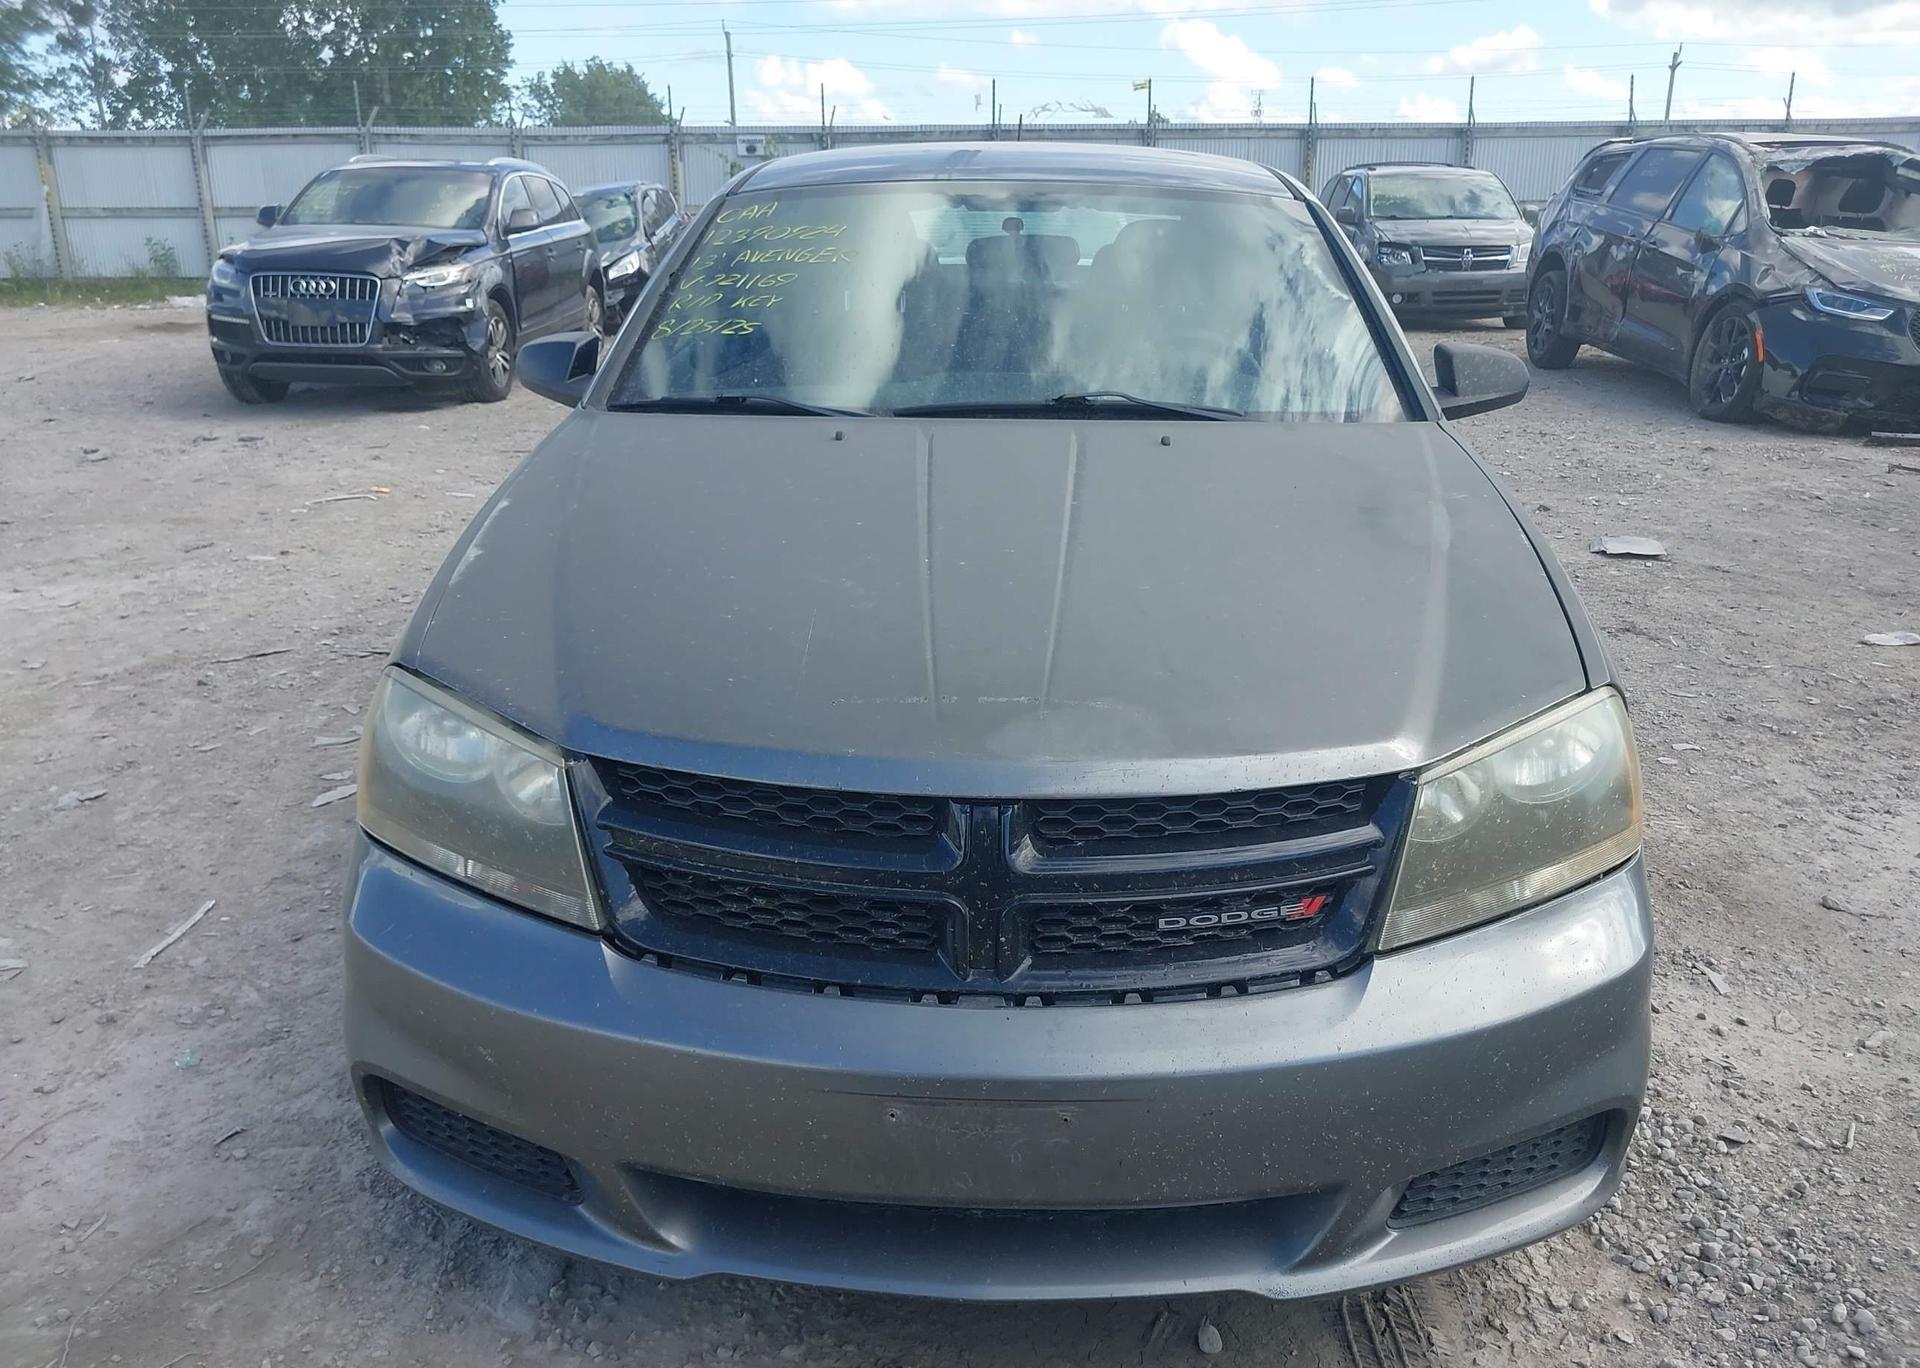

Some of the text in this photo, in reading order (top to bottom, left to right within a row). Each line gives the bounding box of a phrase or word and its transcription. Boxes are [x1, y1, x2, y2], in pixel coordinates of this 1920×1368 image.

[730, 247, 855, 268] AVENGER
[729, 294, 785, 309] KEY
[1158, 902, 1305, 929] DODGE
